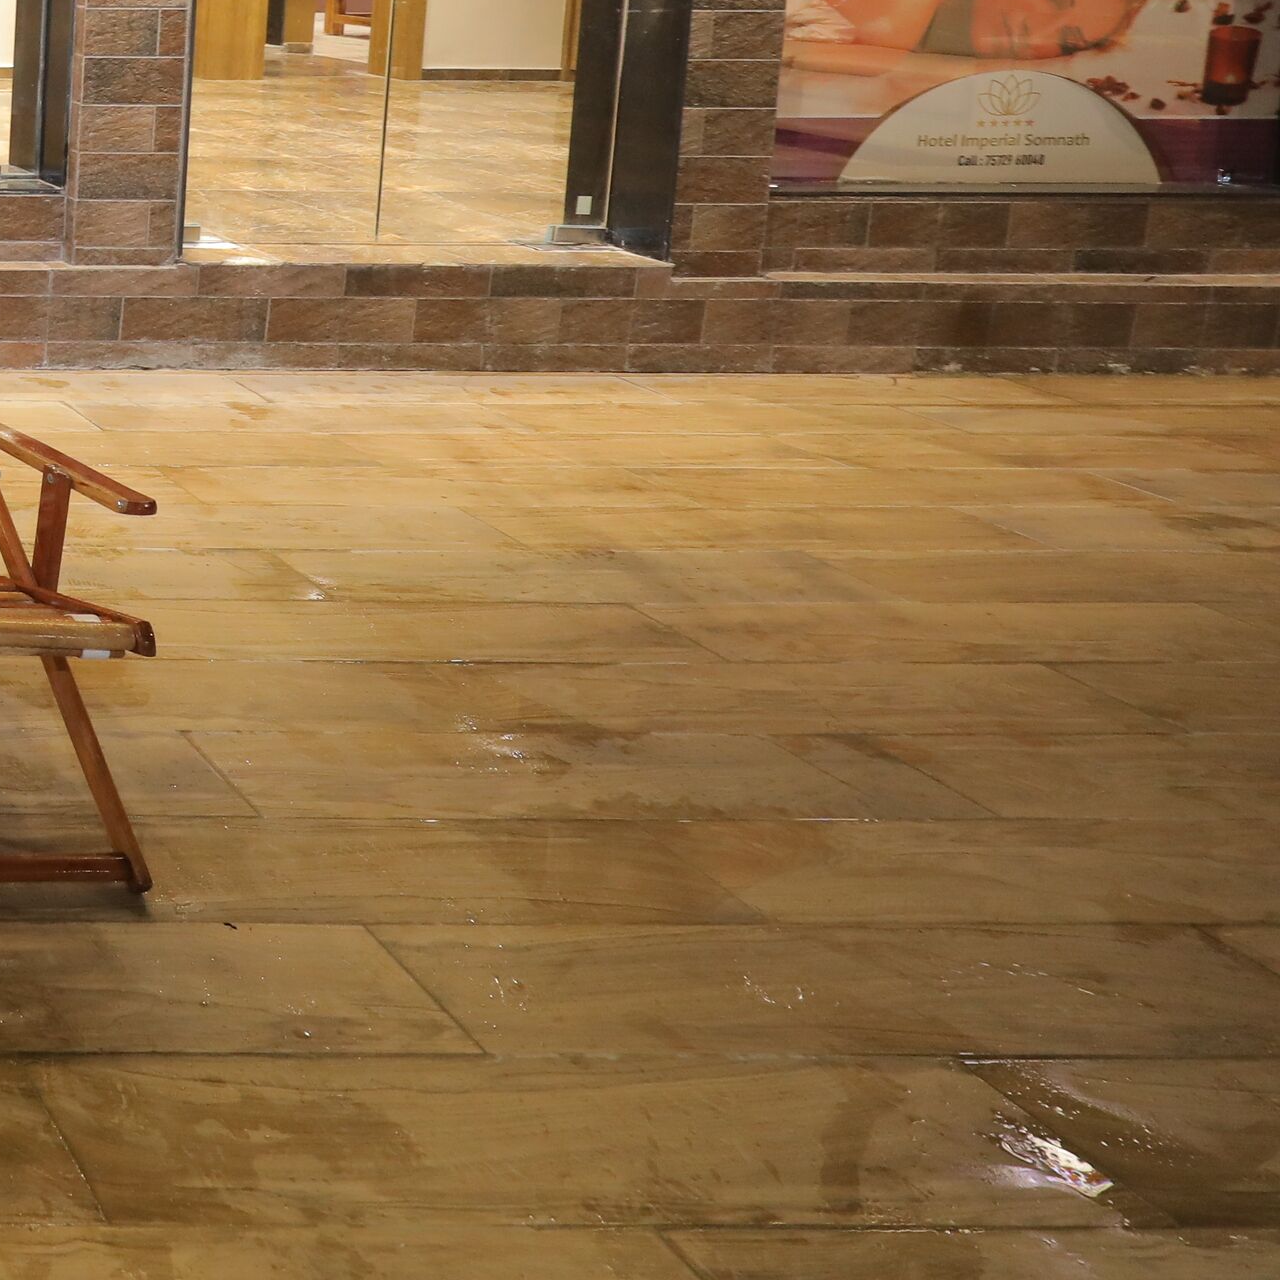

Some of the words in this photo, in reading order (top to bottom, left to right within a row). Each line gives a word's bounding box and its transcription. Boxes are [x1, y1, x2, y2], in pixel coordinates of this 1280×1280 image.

[917, 134, 958, 148] Hotel
[961, 133, 1021, 150] Imperial
[1024, 133, 1091, 147] Somnath
